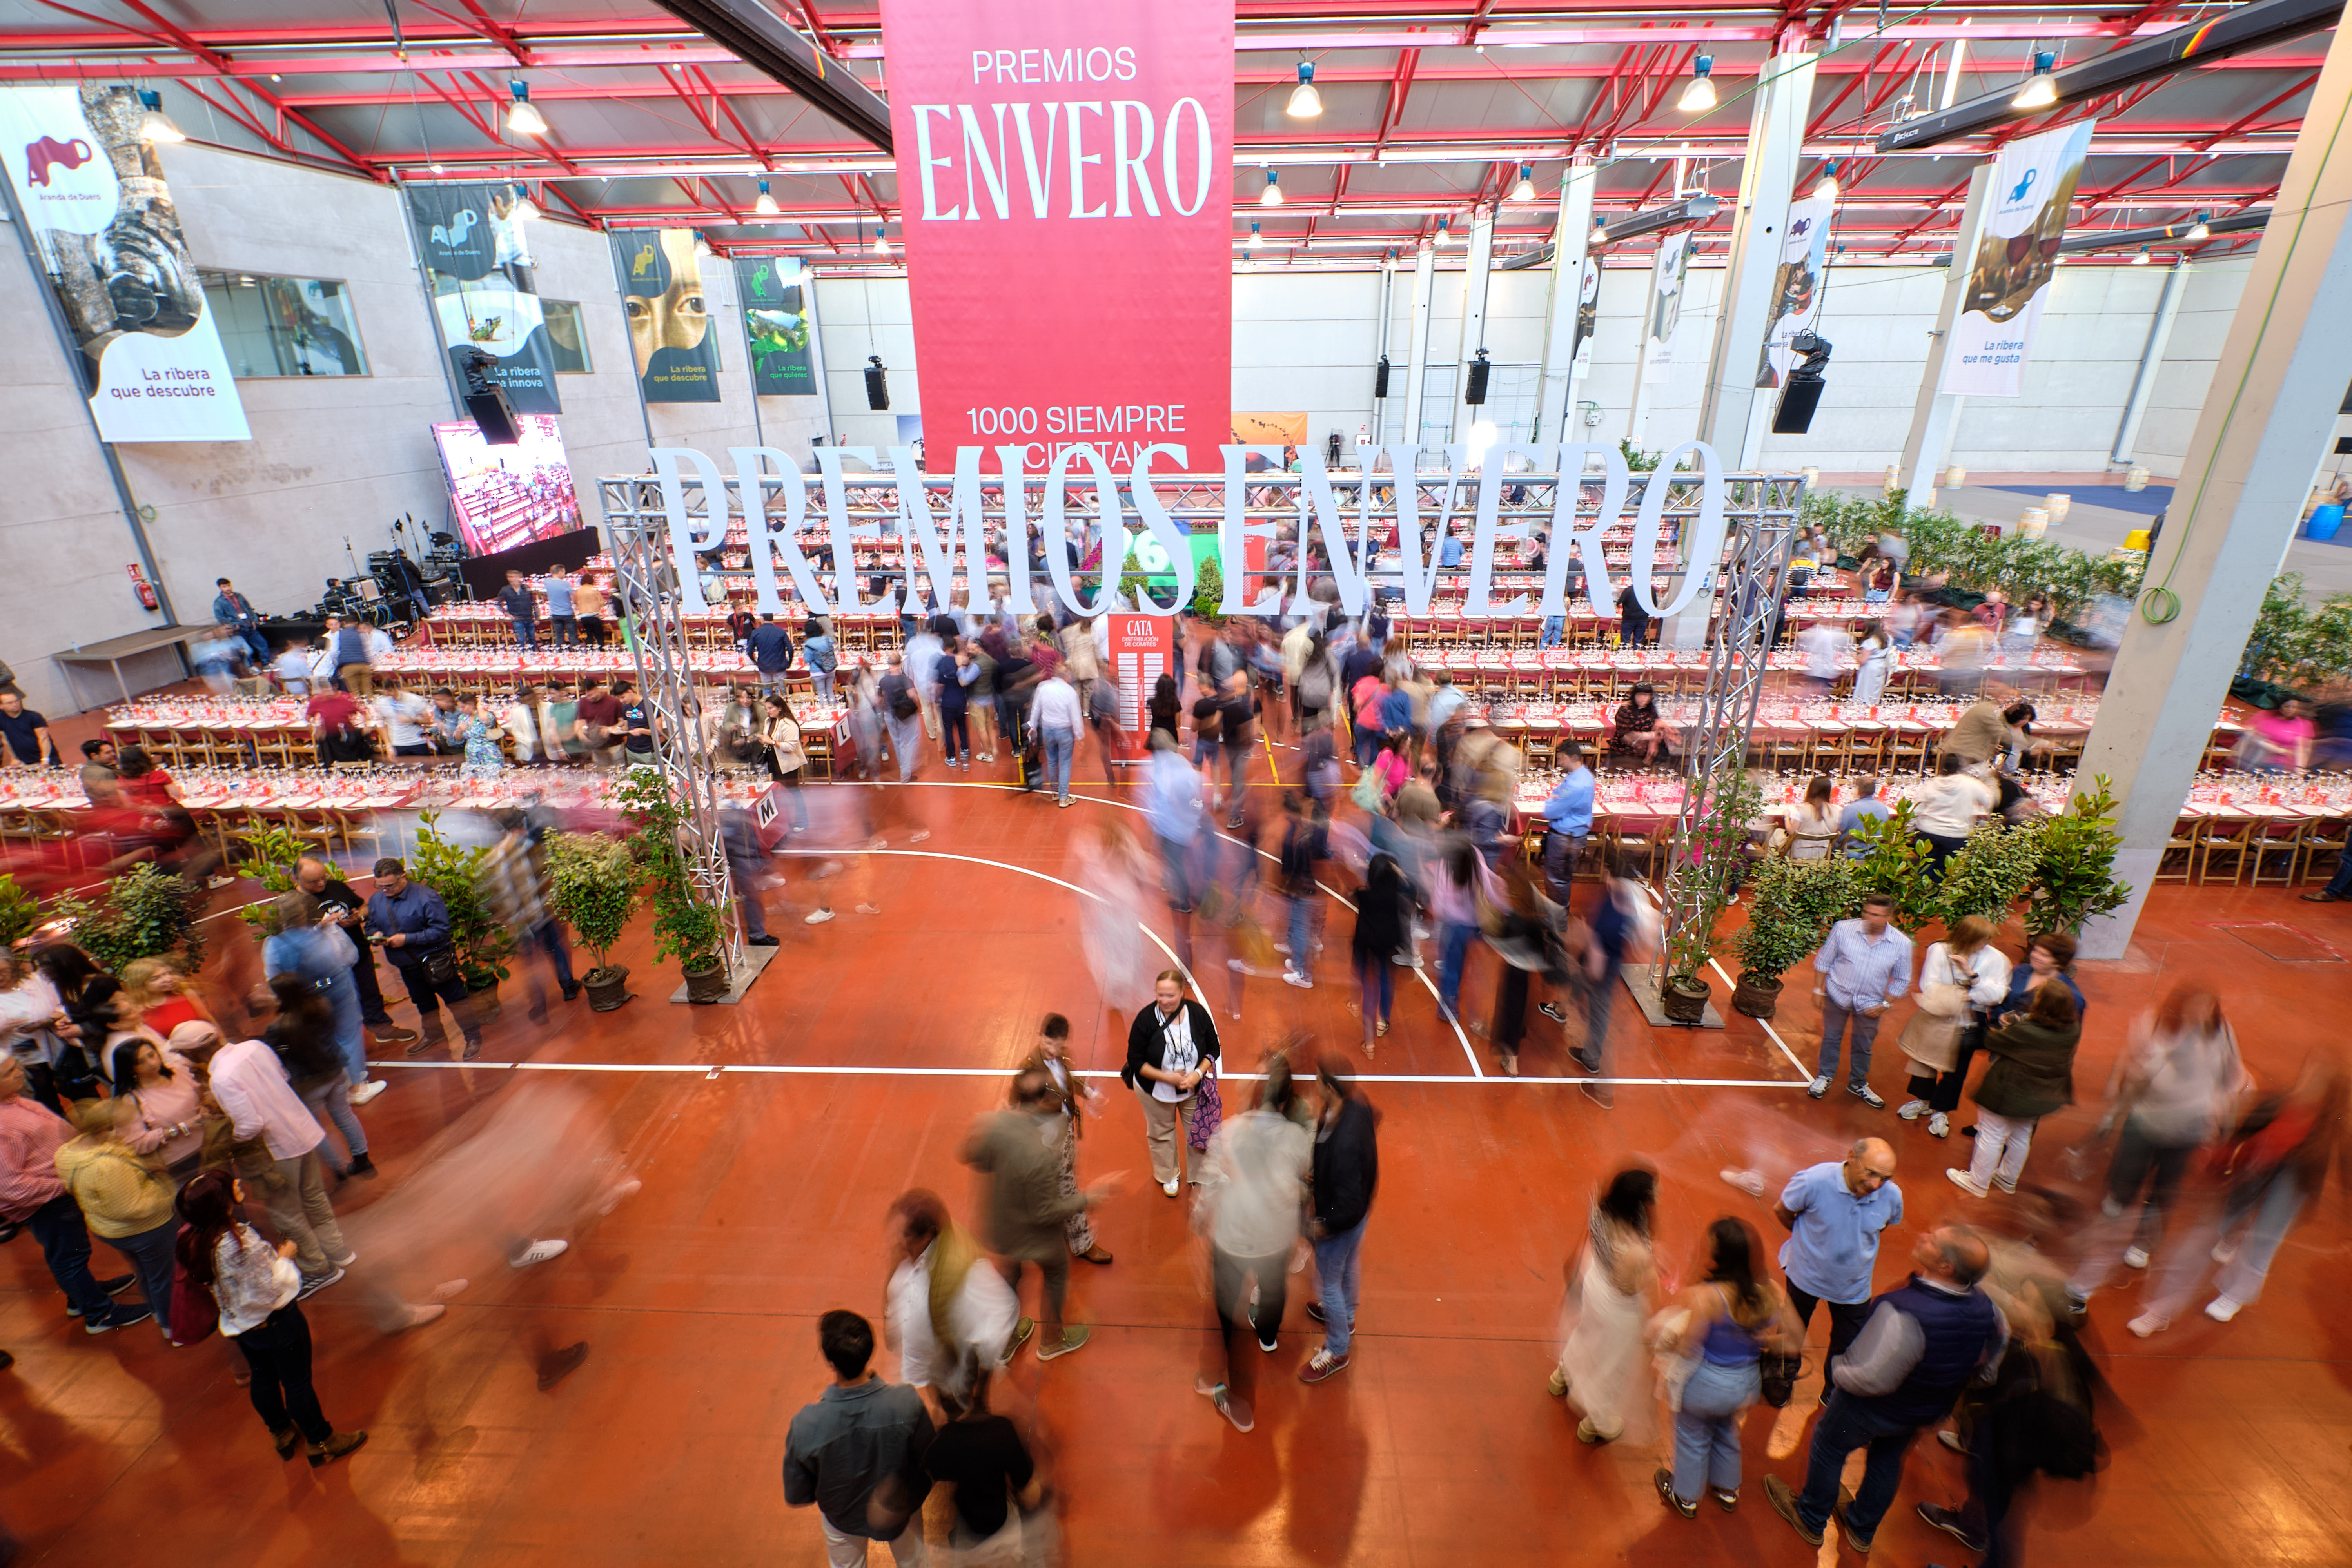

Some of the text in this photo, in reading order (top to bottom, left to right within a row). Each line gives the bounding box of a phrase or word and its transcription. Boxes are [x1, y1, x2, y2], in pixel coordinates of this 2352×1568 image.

[972, 46, 1137, 84] PREMIOS
[911, 97, 1212, 221] ENVERO
[1984, 340, 2024, 350] La ribera
[1962, 356, 1978, 365] que
[1994, 354, 2020, 365] gusta
[142, 367, 211, 380] La ribera
[494, 366, 541, 376] La ribera
[508, 377, 543, 387] innova
[111, 384, 216, 400] que descubre
[966, 405, 1185, 435] 1000 SIEMPRE
[649, 441, 1724, 617] PREMIOS ENVERO
[1127, 620, 1153, 636] CATA
[840, 724, 847, 740] L
[761, 798, 775, 824] M
